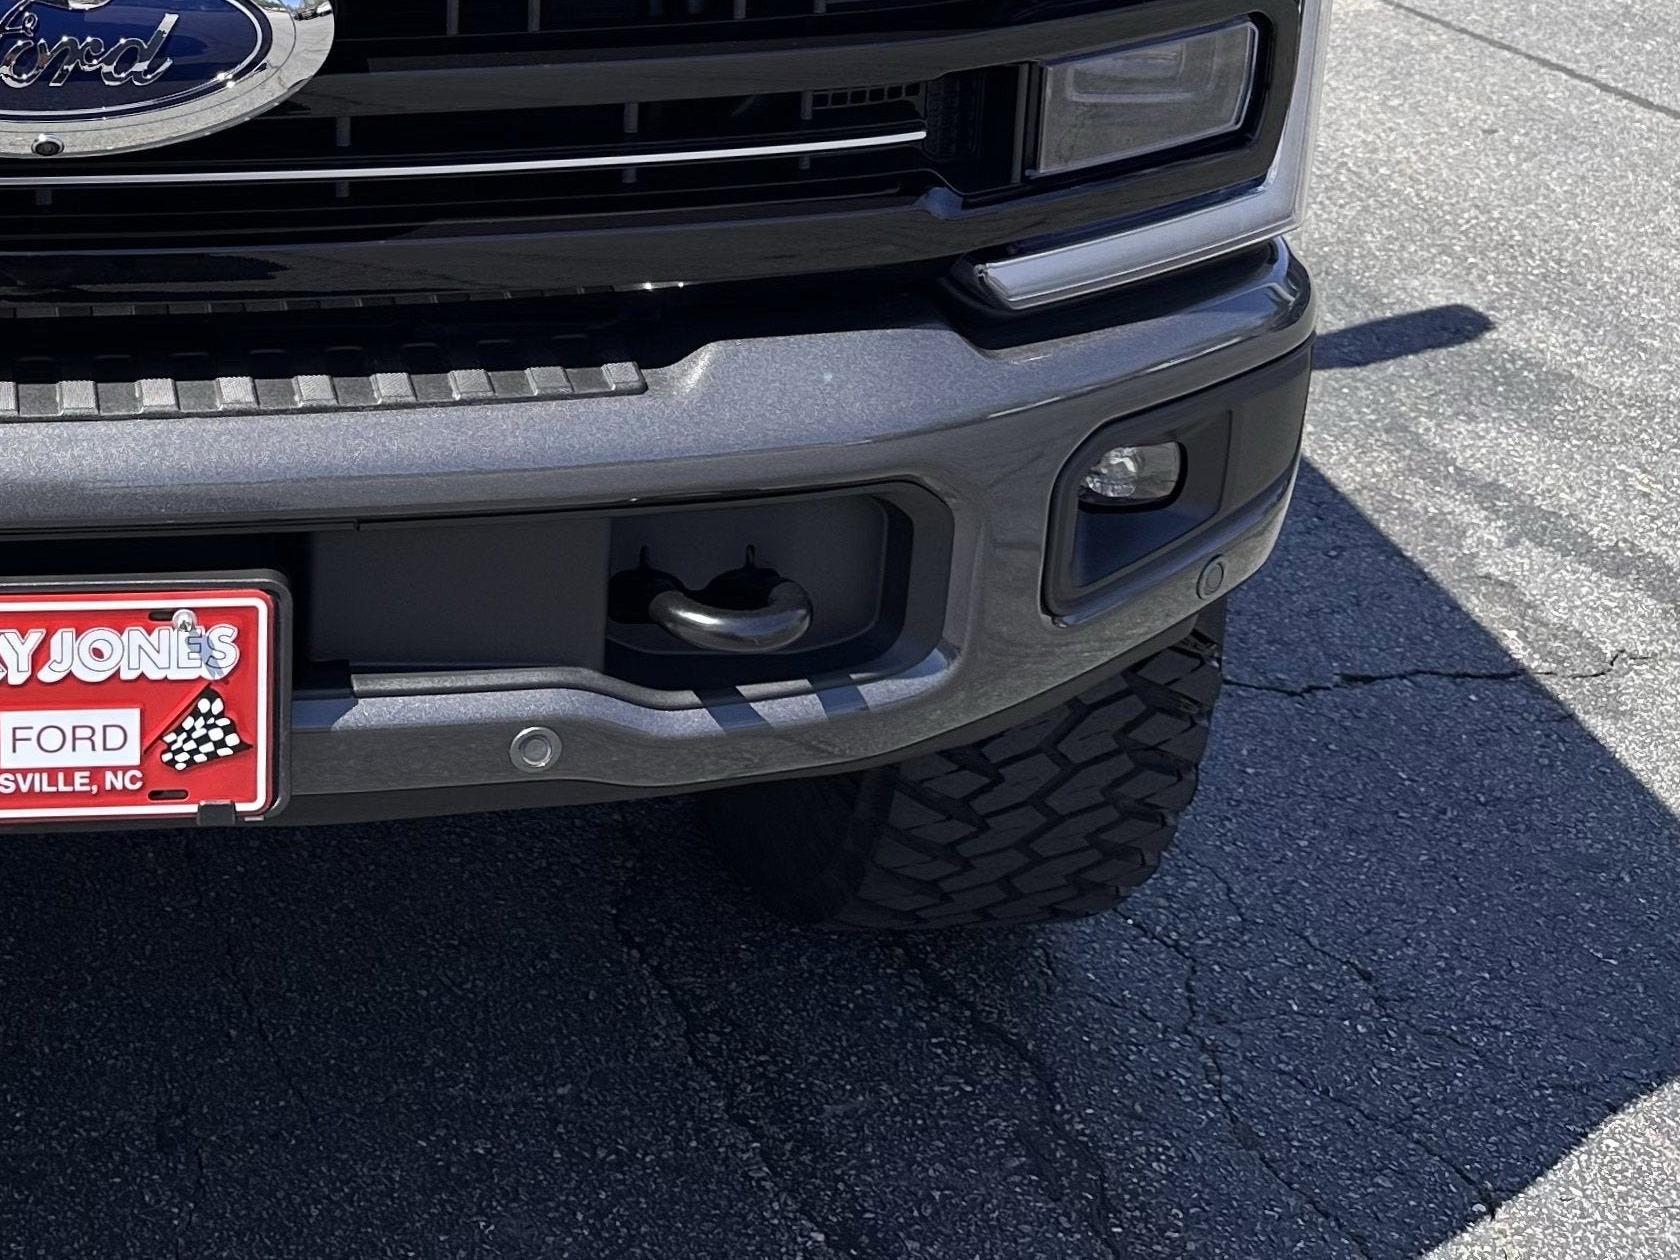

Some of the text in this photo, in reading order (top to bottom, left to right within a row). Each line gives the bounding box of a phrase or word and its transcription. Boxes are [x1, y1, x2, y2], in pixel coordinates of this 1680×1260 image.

[36, 624, 241, 684] JONES
[11, 724, 128, 754] FORD
[104, 769, 144, 791] NC
